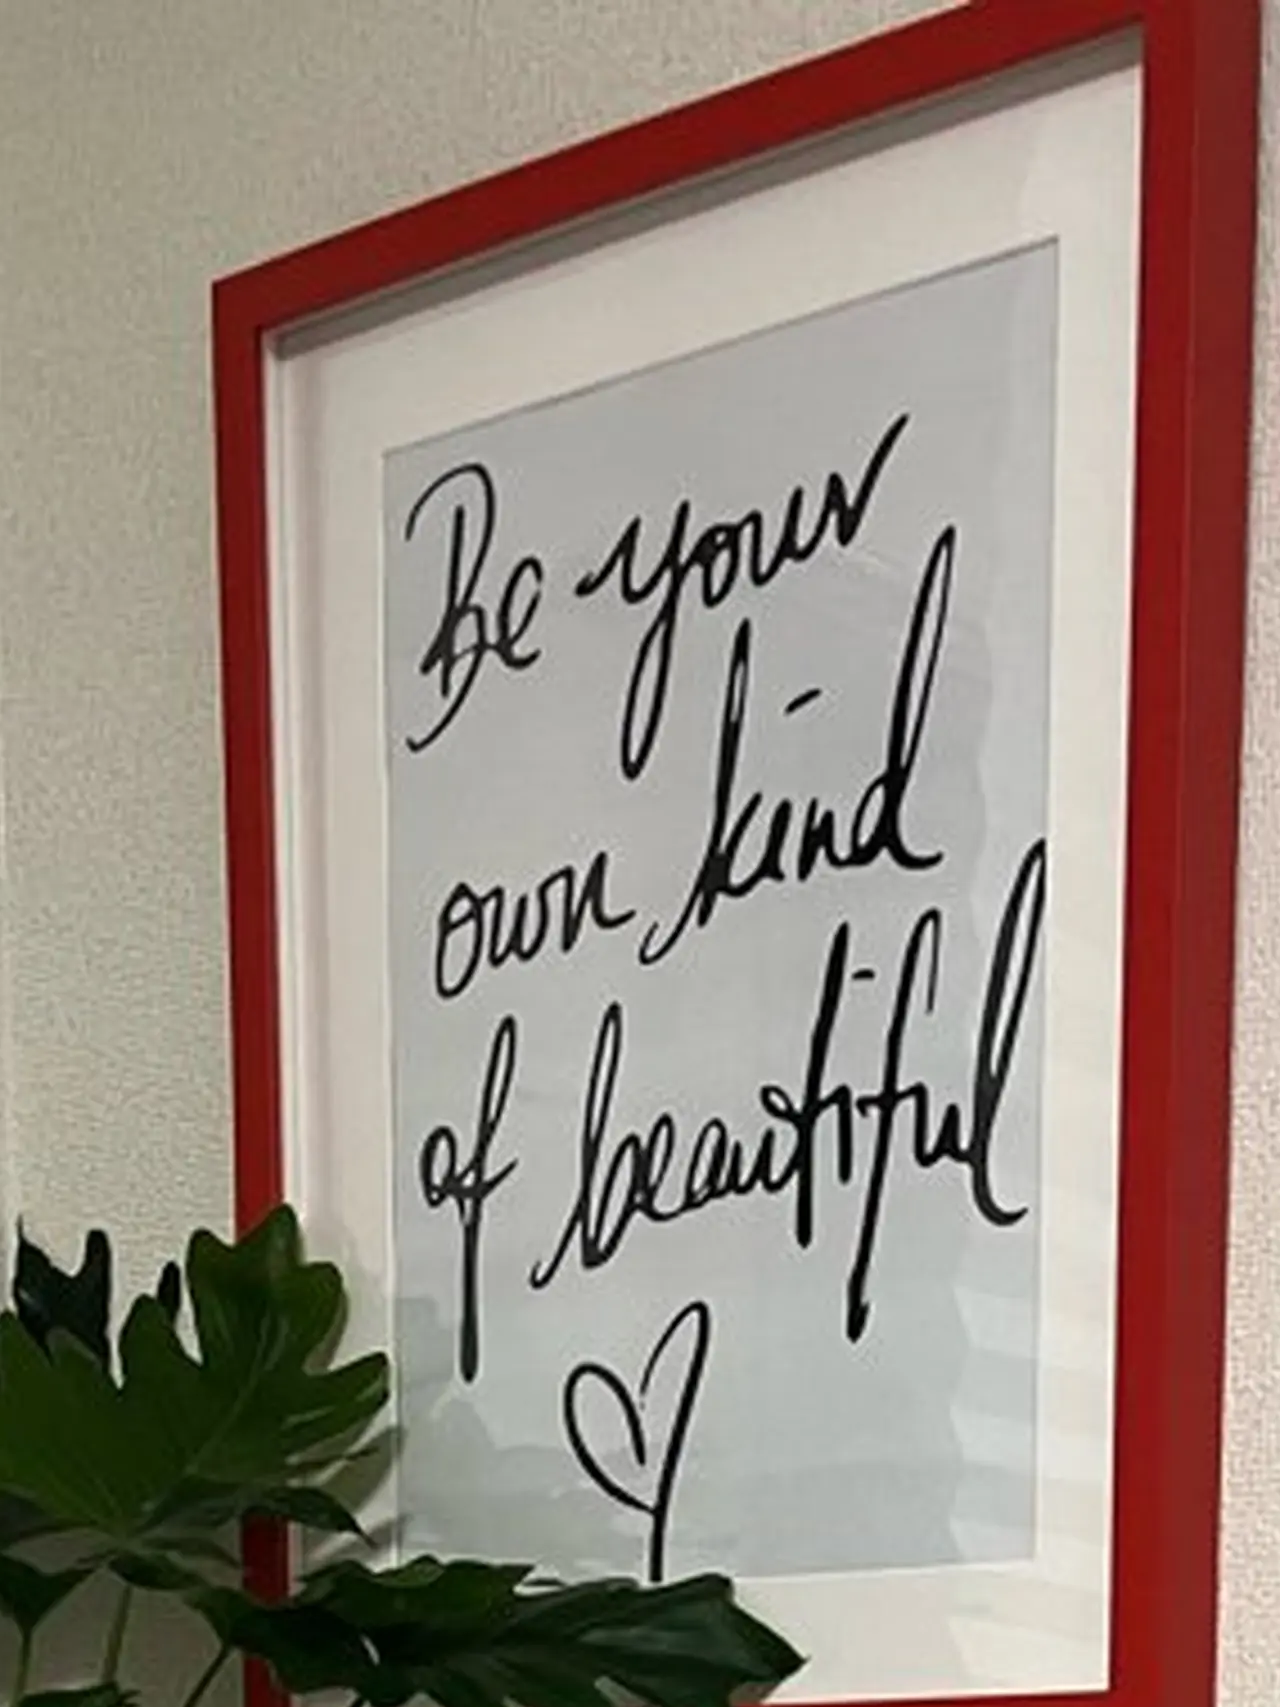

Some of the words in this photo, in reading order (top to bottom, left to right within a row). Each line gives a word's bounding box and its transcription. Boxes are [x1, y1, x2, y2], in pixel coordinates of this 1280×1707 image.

[405, 462, 543, 753] Be
[575, 413, 909, 781] your
[435, 851, 636, 999] own
[639, 524, 956, 966] kind
[420, 1015, 517, 1384] of
[529, 838, 1047, 1344] beautiful
